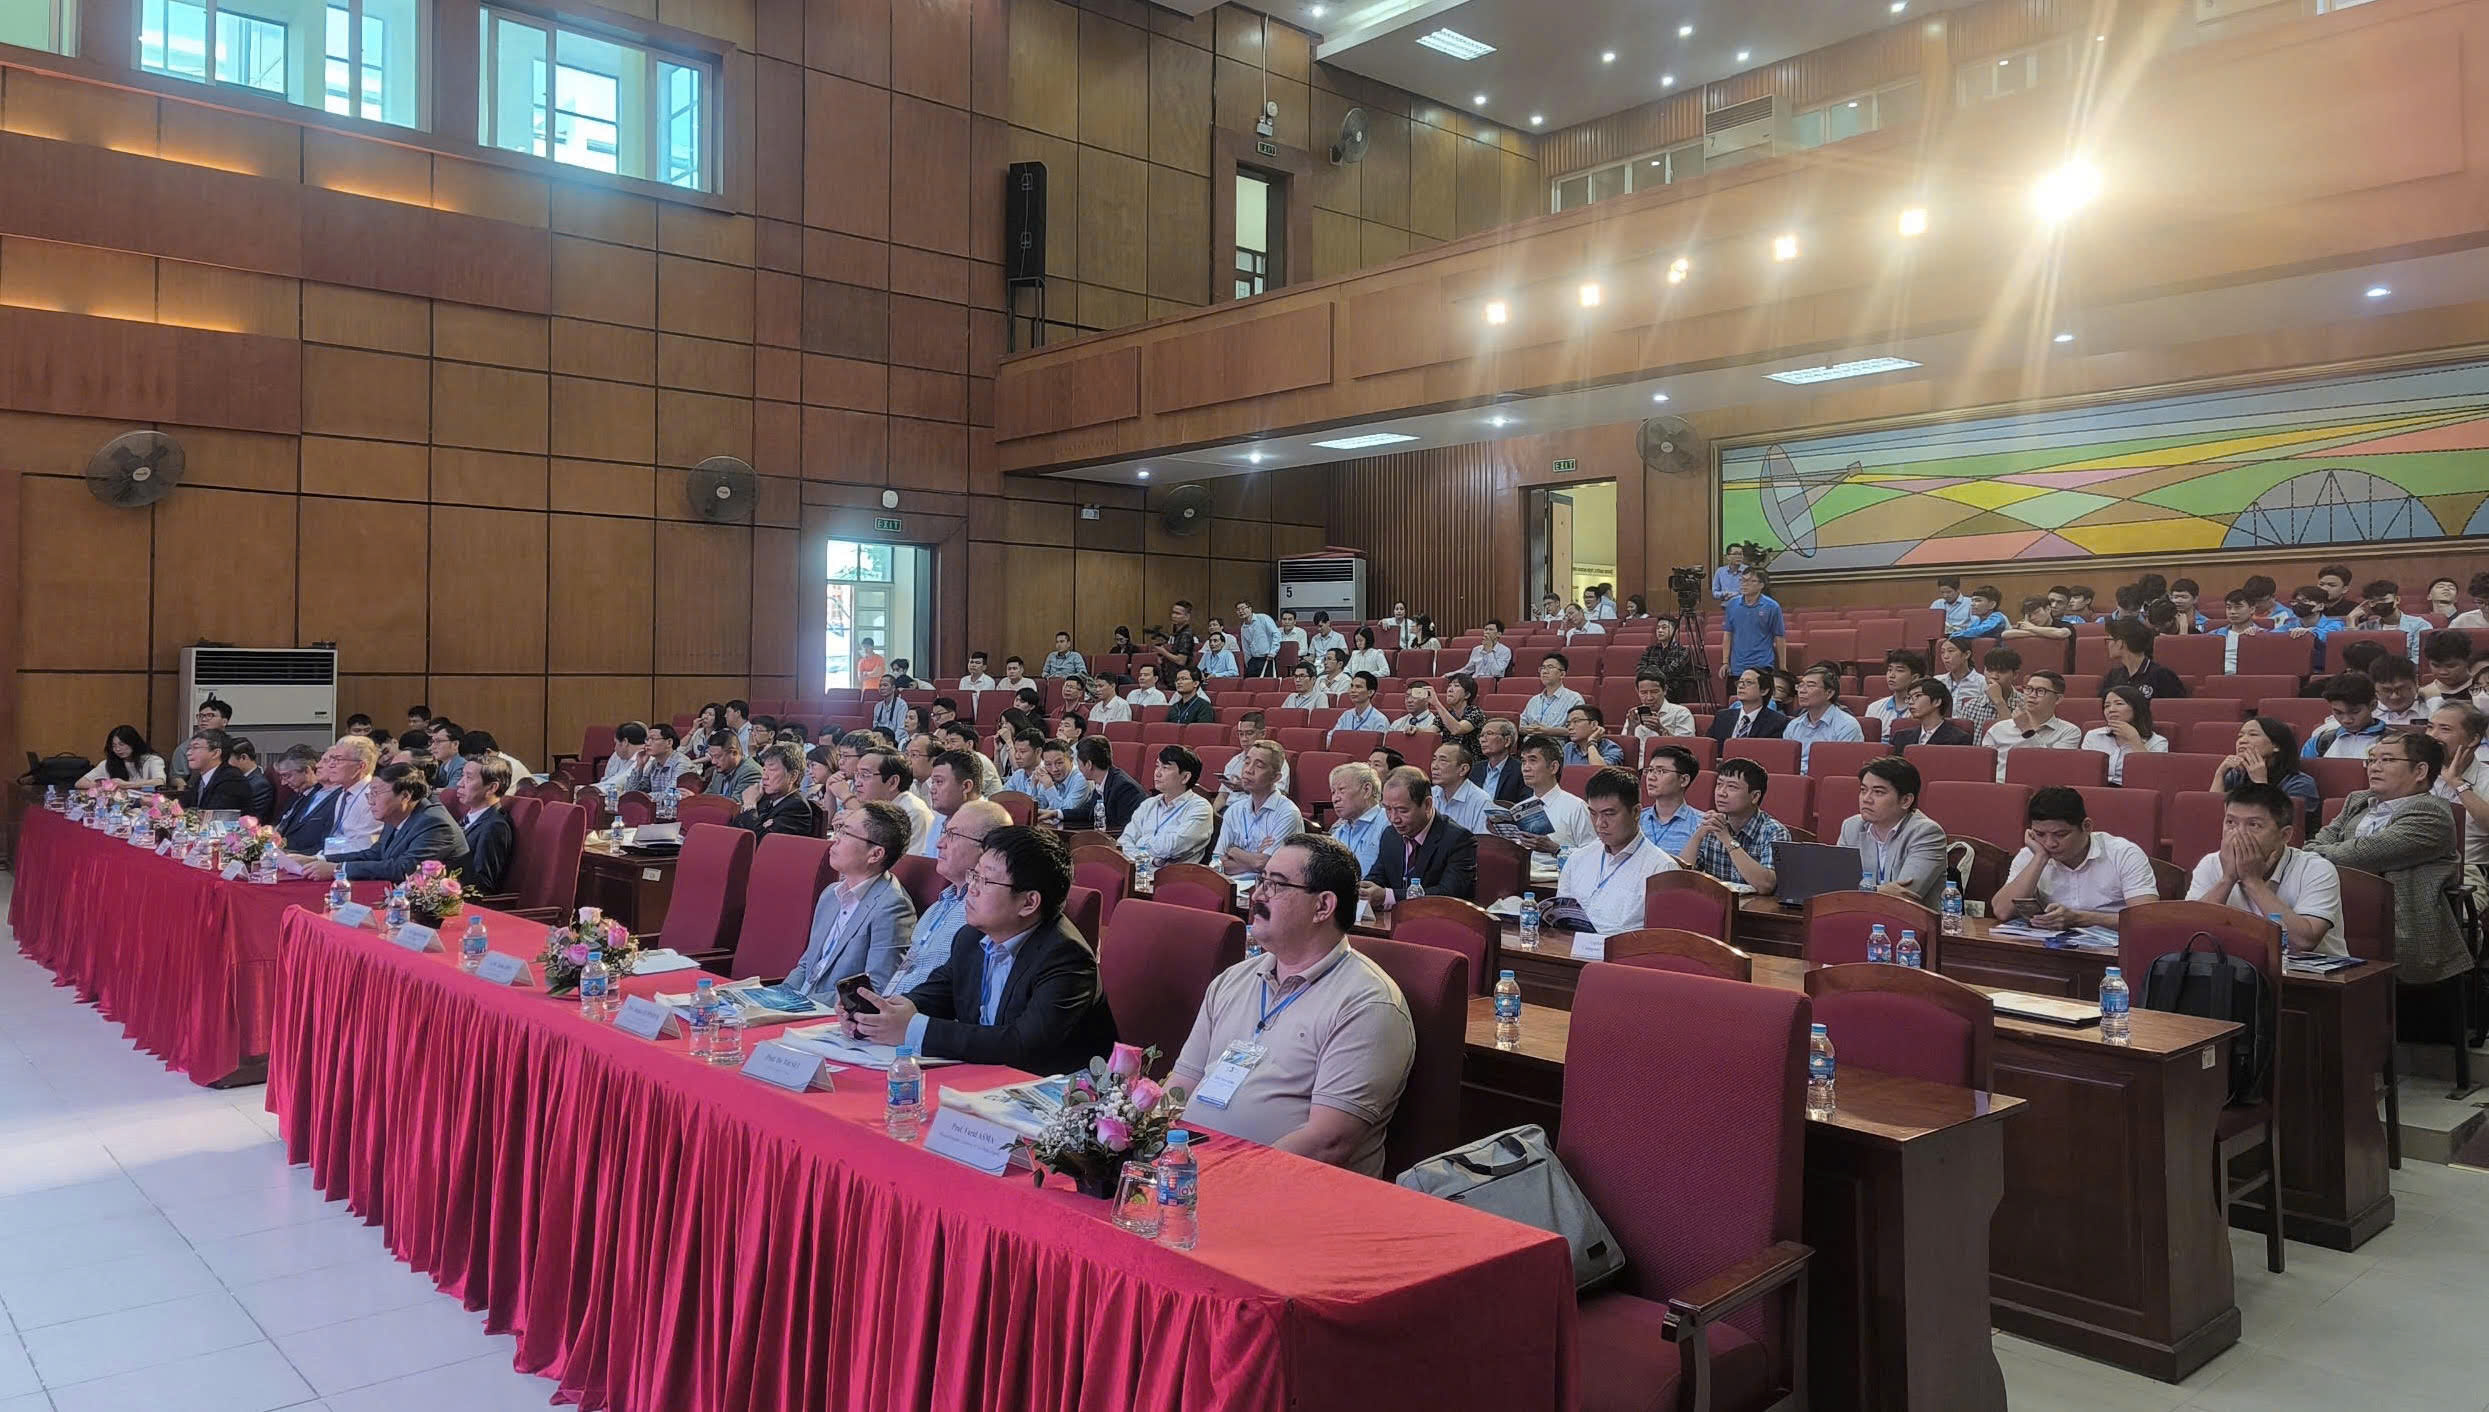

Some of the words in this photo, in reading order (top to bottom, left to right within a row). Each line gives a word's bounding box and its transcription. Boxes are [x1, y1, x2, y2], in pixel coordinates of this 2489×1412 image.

[1555, 461, 1573, 470] EXIT
[877, 519, 898, 529] EXIT
[1286, 586, 1293, 598] 5
